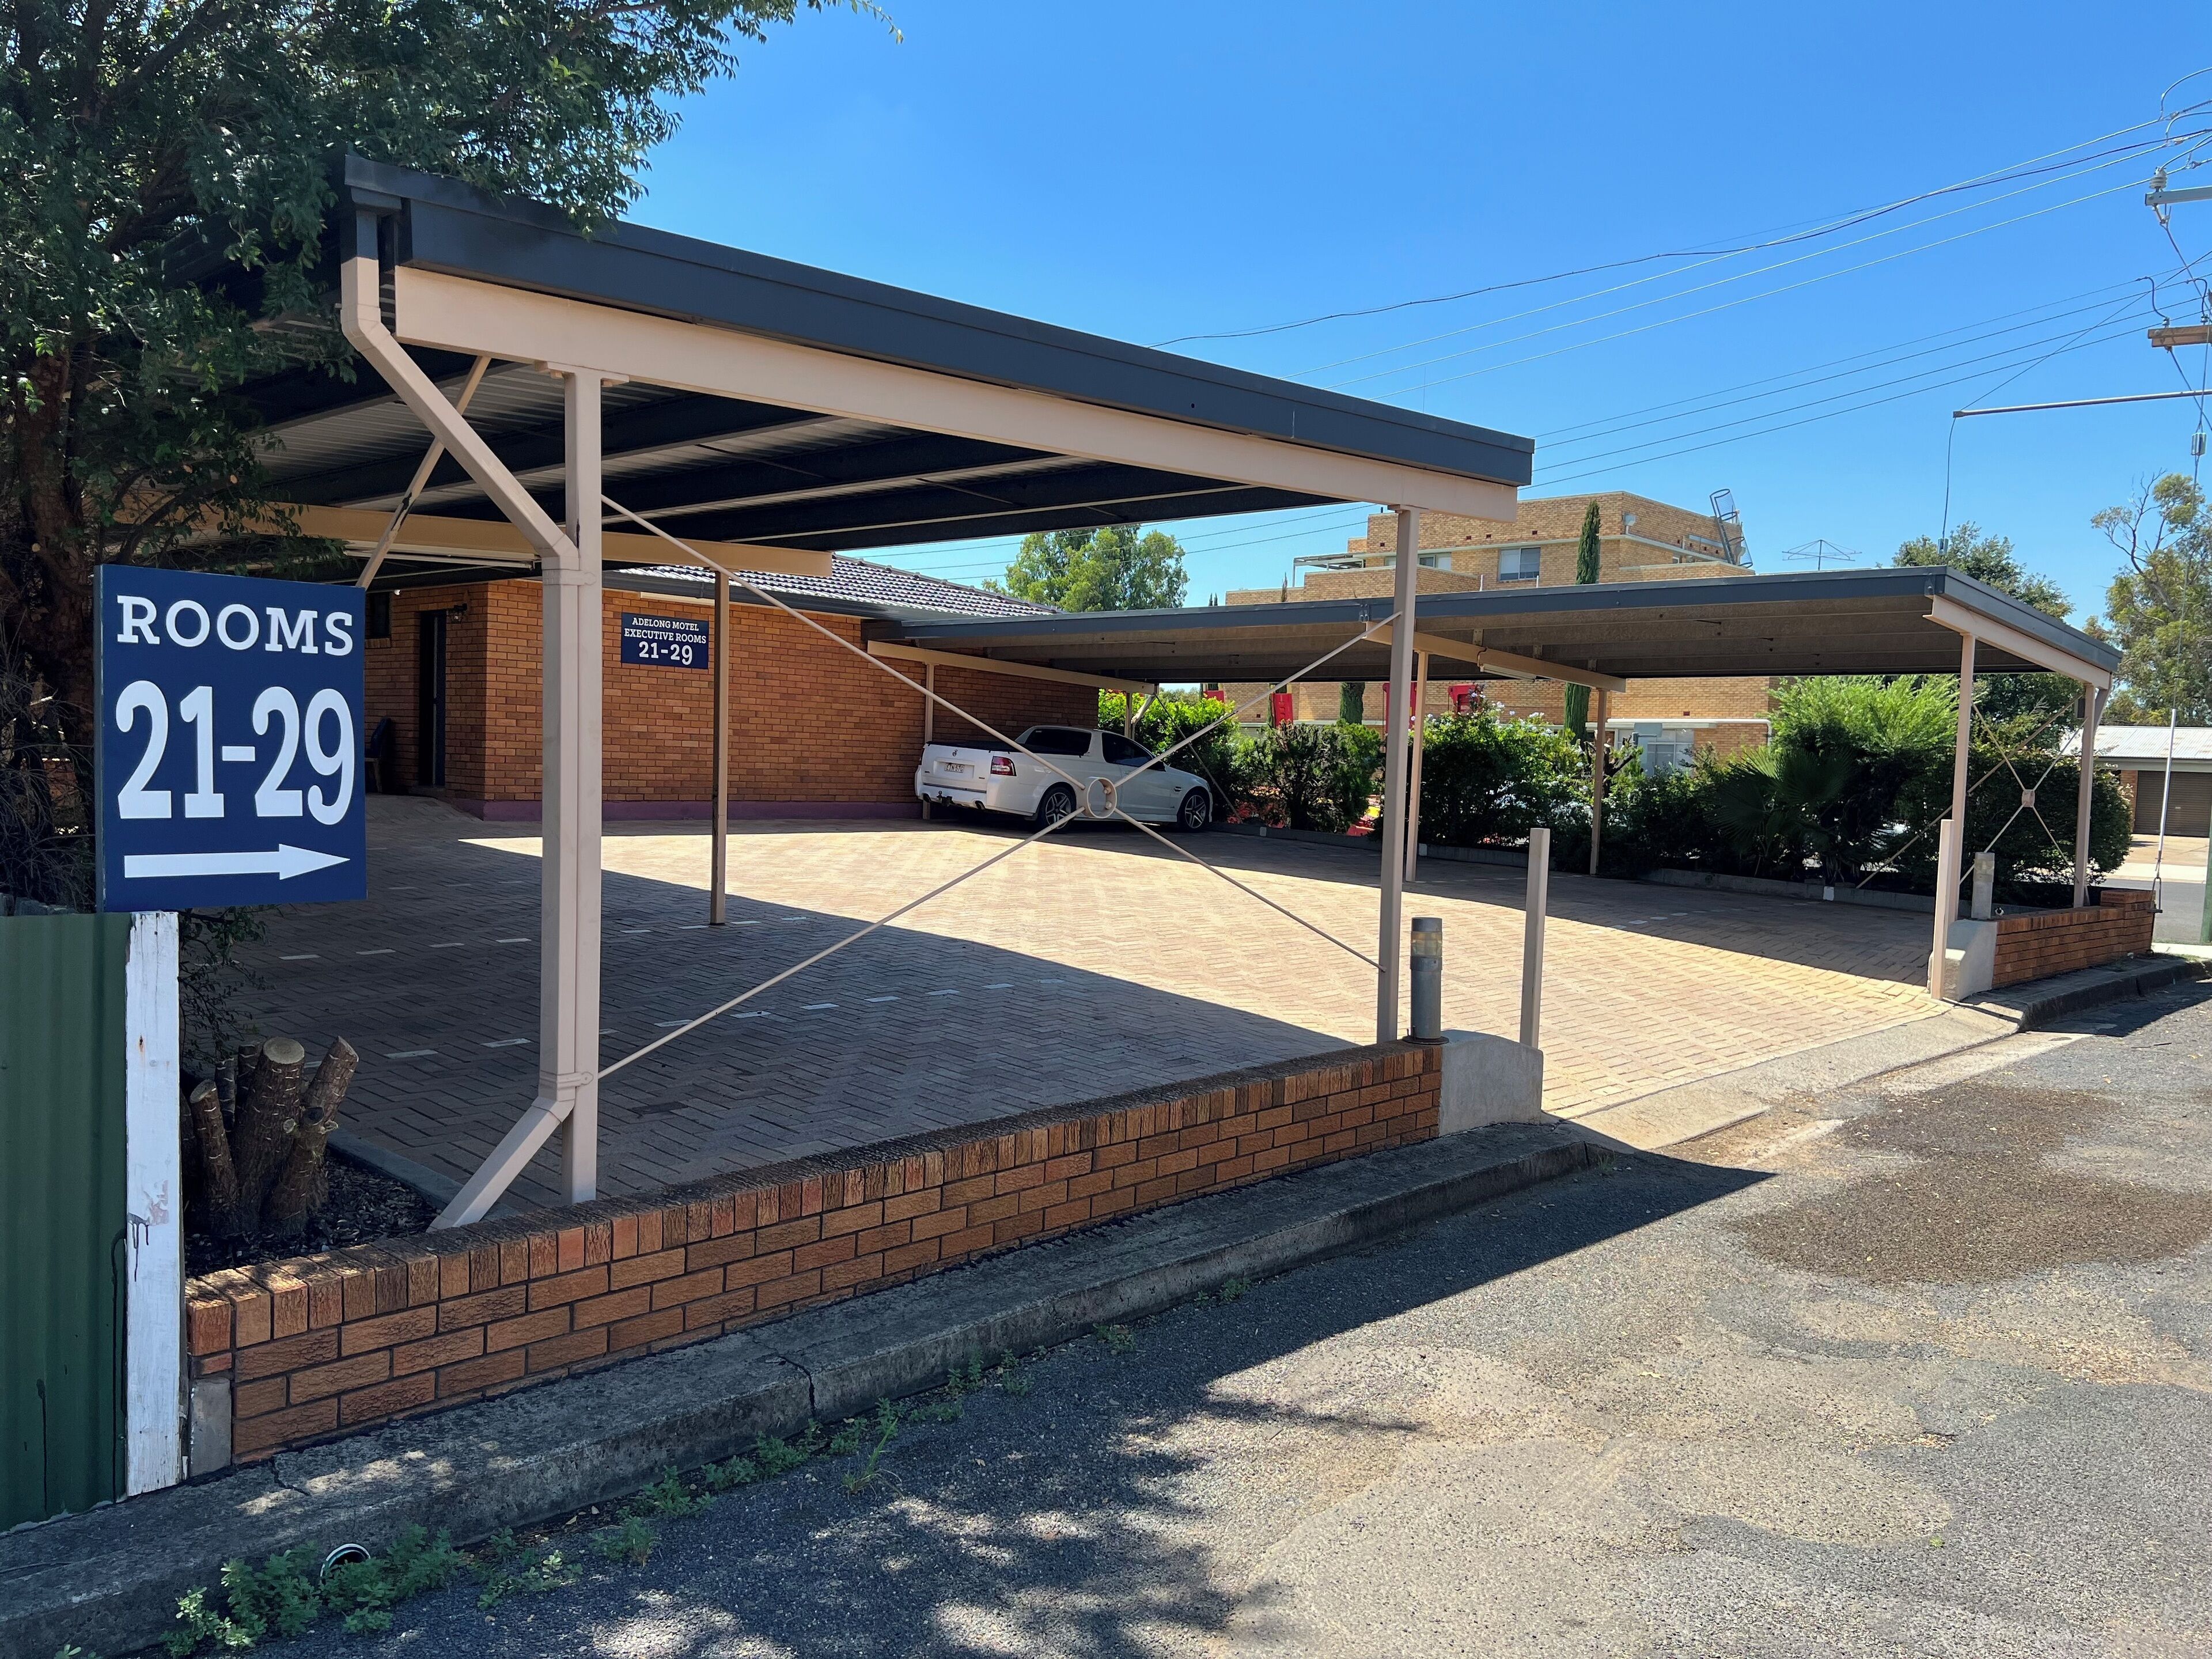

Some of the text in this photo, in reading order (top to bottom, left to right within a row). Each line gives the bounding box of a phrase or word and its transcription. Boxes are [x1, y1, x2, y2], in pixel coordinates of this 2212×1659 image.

[117, 594, 353, 657] ROOMS
[624, 628, 706, 644] EXECUTIVE ROOMS
[632, 618, 699, 631] ADELONG MOTEL
[638, 641, 692, 665] 21-29
[115, 680, 355, 825] 21-29
